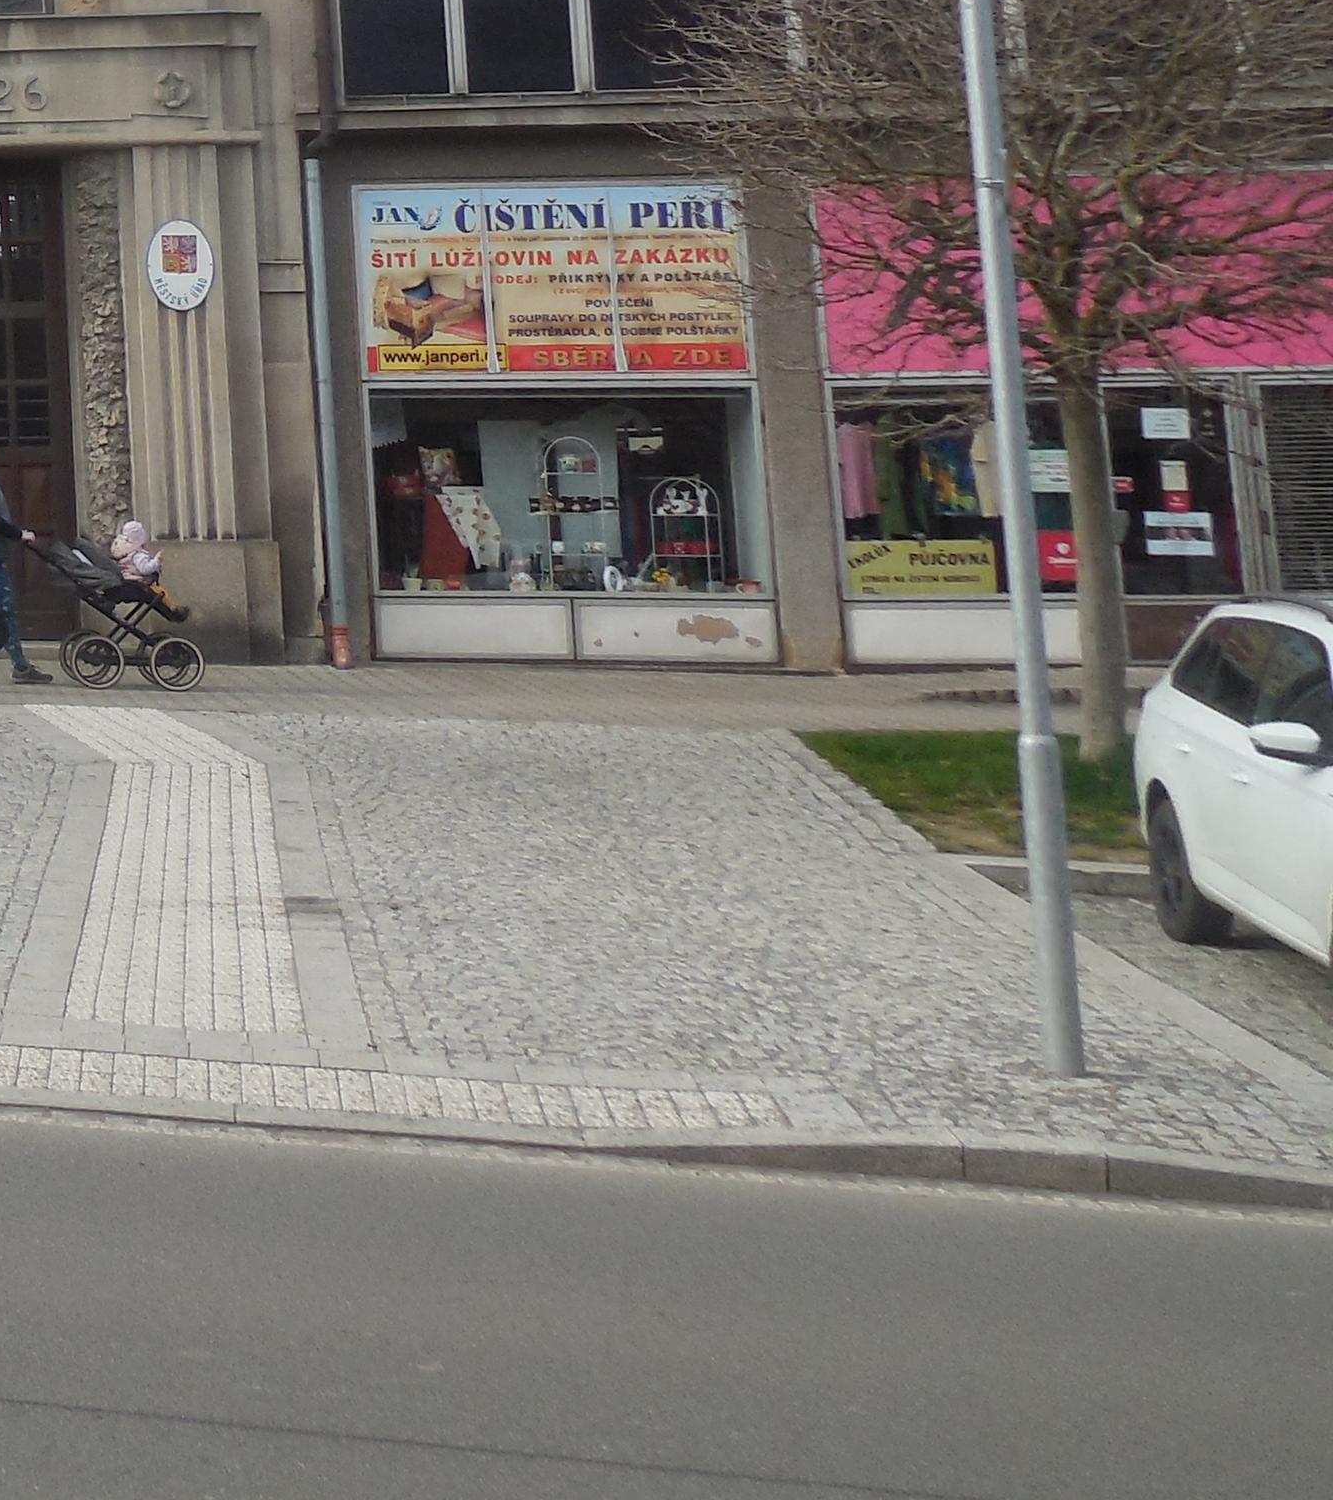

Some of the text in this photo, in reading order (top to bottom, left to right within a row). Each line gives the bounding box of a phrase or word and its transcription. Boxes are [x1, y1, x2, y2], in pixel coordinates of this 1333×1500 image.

[371, 248, 416, 268] ŠITÍ
[567, 250, 599, 265] NA
[615, 245, 731, 265] ZAKÁZKU
[640, 274, 650, 282] A
[509, 313, 579, 324] SOUPRAVY
[578, 313, 597, 323] DO
[673, 349, 732, 366] ZDE
